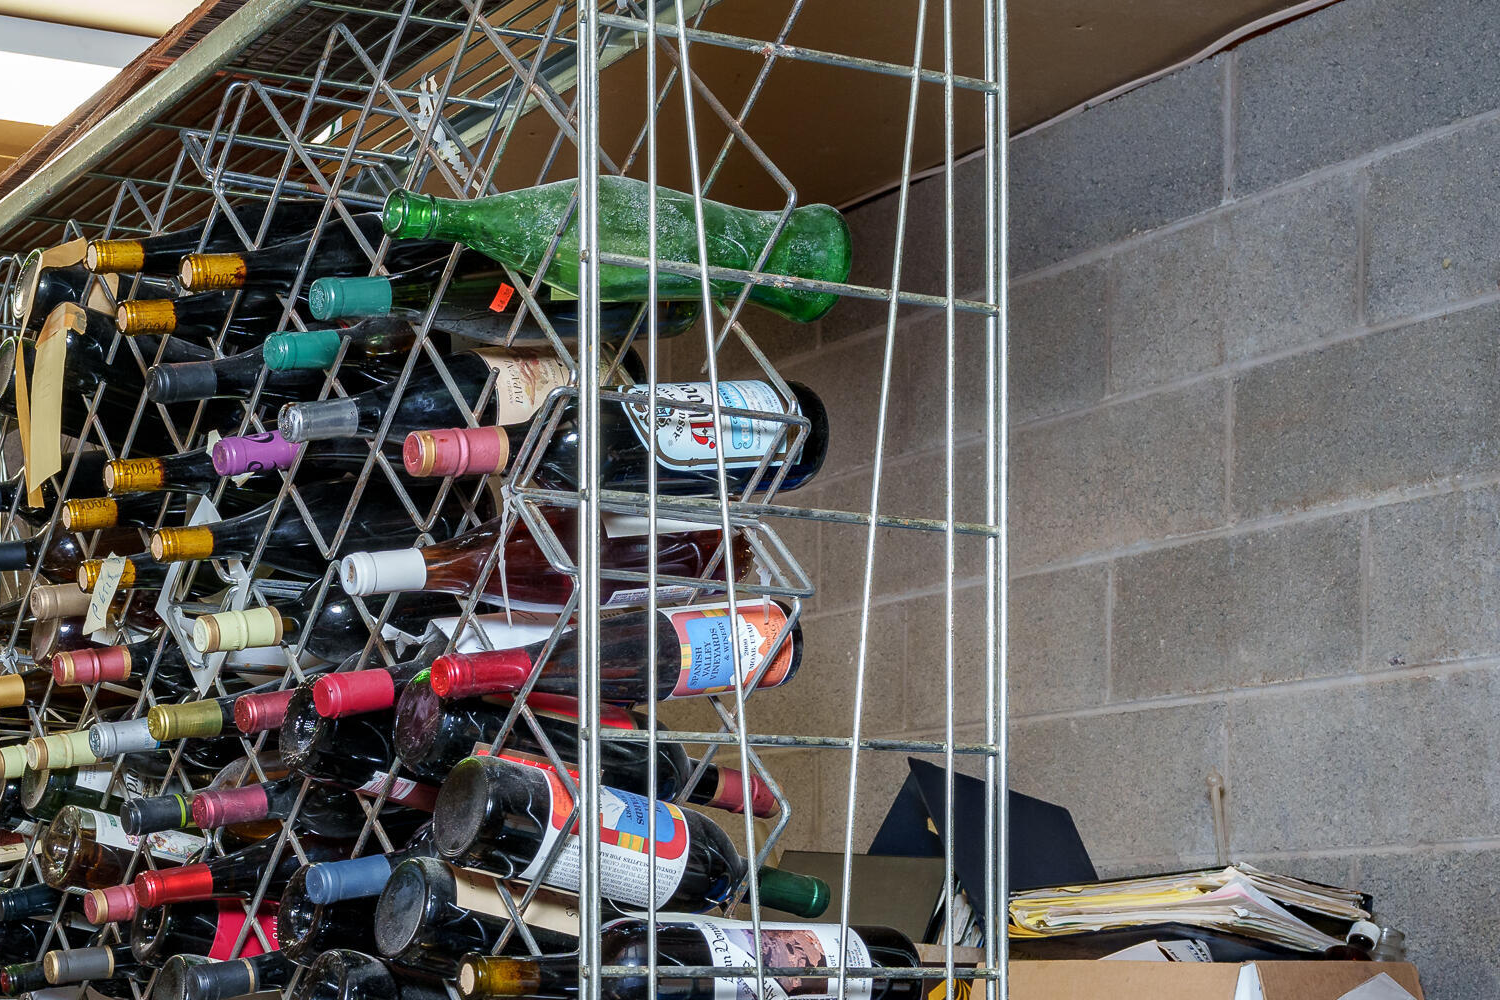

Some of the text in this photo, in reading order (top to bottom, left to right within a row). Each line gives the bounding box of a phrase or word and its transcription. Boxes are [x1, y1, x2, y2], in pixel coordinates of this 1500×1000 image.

[123, 462, 162, 476] 2004
[709, 627, 721, 681] VINEYARDS
[717, 620, 730, 653] WINERY
[690, 646, 703, 686] SPANISH
[702, 641, 712, 677] VALLEY
